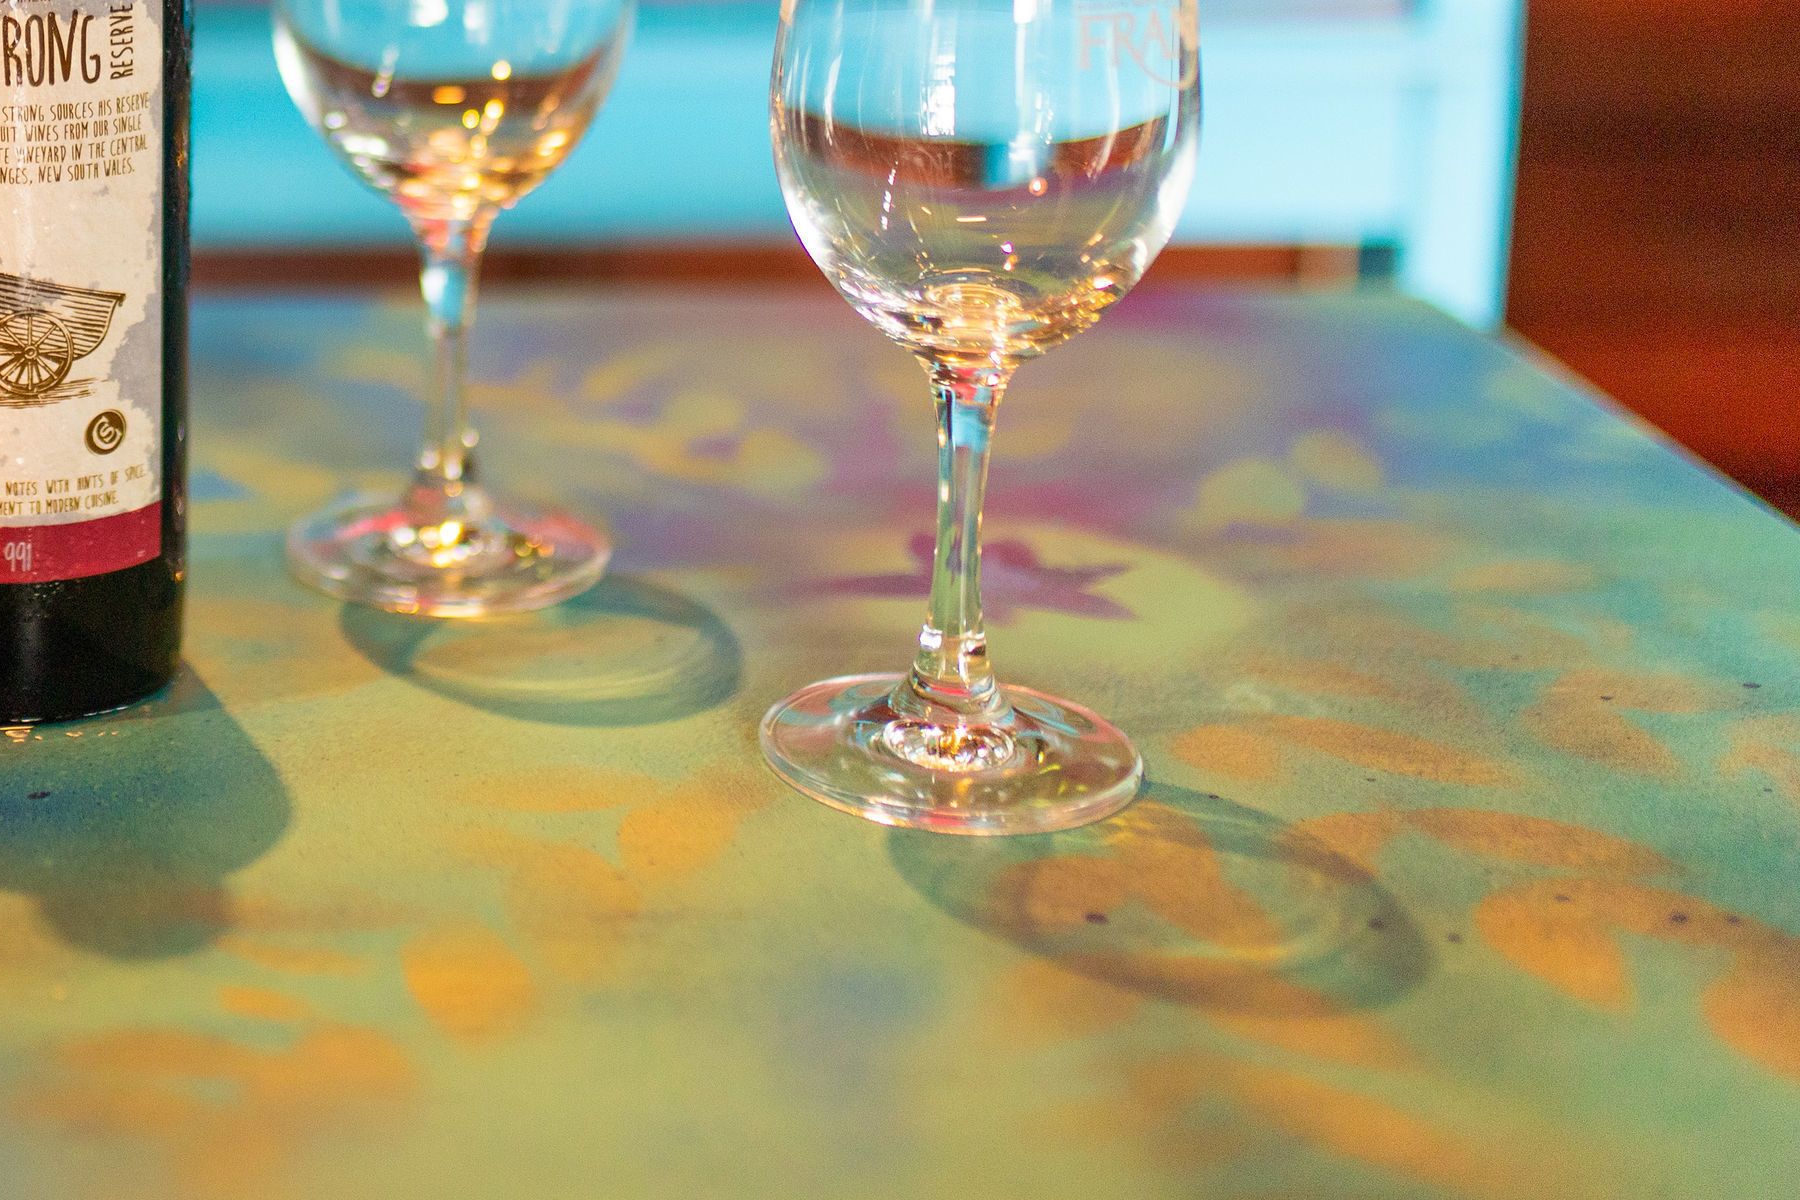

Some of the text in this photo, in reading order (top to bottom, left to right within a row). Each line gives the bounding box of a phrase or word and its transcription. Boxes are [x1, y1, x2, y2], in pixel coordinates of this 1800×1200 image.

[110, 3, 134, 80] RESERVE
[2, 104, 45, 123] STRONG
[50, 102, 94, 121] SOURCES
[98, 99, 112, 117] HIS
[116, 92, 149, 115] RESERVE
[24, 124, 59, 142] WINES
[64, 121, 89, 140] FROM
[93, 120, 109, 138] OUR
[113, 114, 142, 135] SINGLE
[71, 143, 83, 161] IN
[88, 141, 106, 159] THE
[110, 134, 148, 157] CENTRAL
[38, 165, 62, 183] NEW
[67, 162, 99, 182] SOUTH
[103, 157, 135, 177] WALES.
[5, 481, 38, 497] NOTES
[45, 479, 70, 495] WITH
[77, 473, 105, 492] HINTS
[29, 500, 42, 515] TO
[46, 496, 81, 515] MODERN
